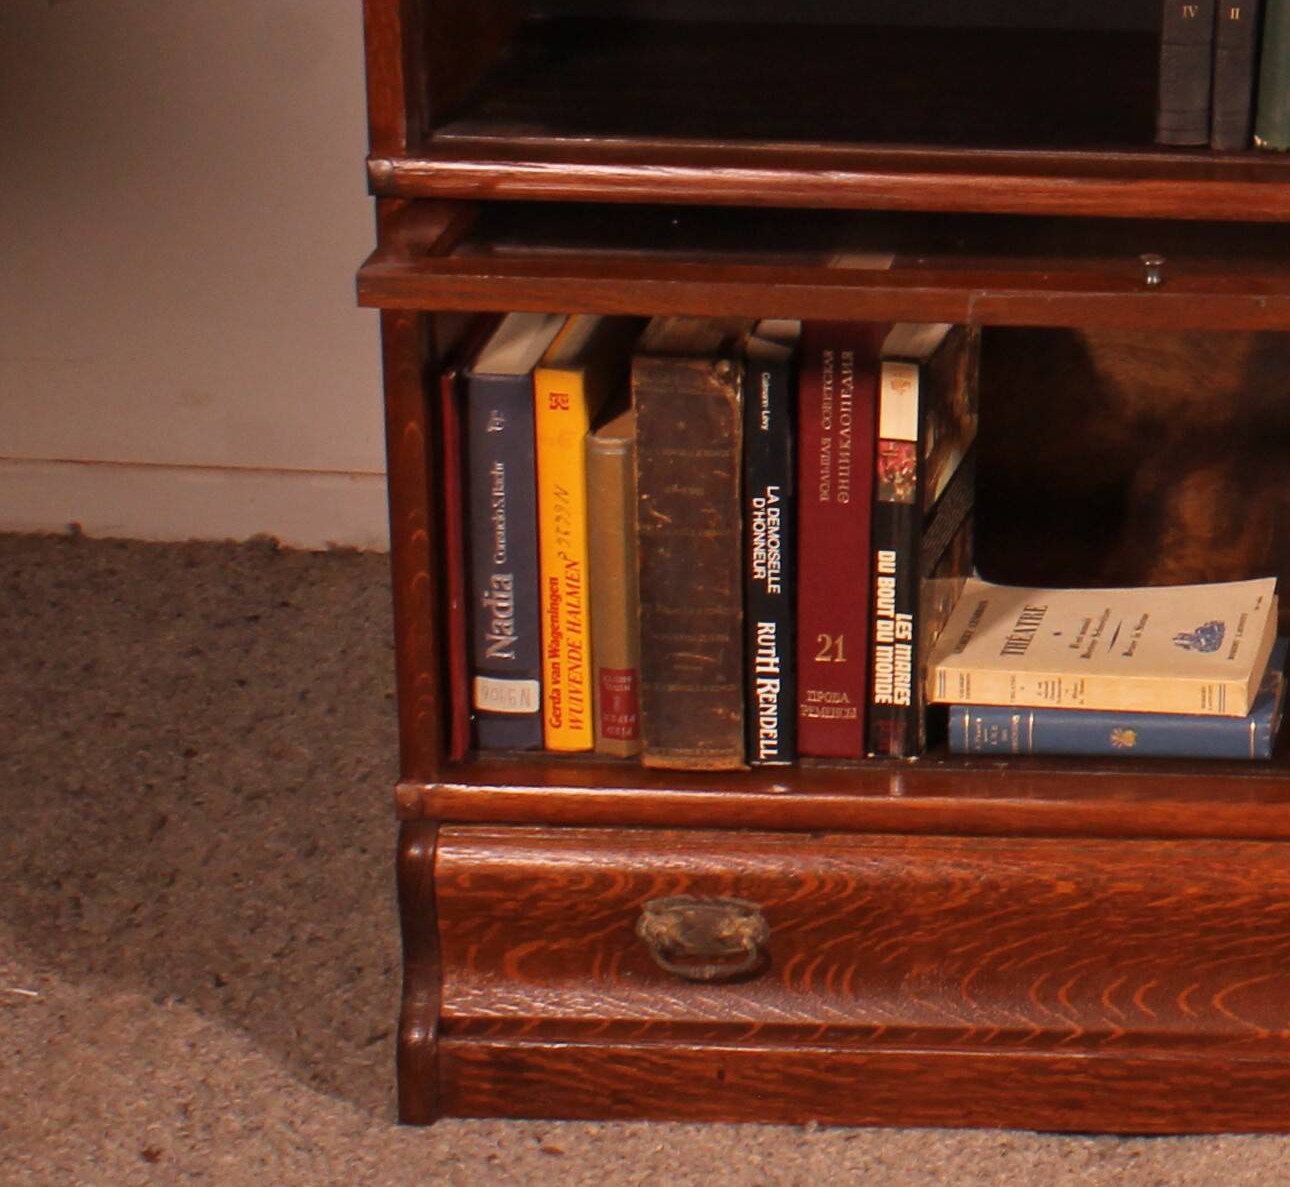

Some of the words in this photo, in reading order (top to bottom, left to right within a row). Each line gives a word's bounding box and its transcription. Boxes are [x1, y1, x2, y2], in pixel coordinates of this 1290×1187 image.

[767, 485, 780, 505] LA
[752, 497, 766, 580] D'HONNEUR
[766, 507, 781, 595] DEMOISELLE
[876, 550, 897, 574] DU
[482, 573, 518, 660] Nadia
[547, 576, 564, 660] Wageningen
[565, 560, 583, 635] HALMEN
[876, 576, 896, 618] BOUT
[755, 621, 781, 674] RUTH
[814, 633, 847, 663] 21
[875, 619, 895, 643] DU
[894, 613, 913, 641] LES
[551, 662, 561, 688] van
[567, 639, 584, 730] WUIVENDE
[874, 645, 894, 705] MONDE
[549, 688, 562, 729] Gerda
[756, 678, 781, 760] RENDELL
